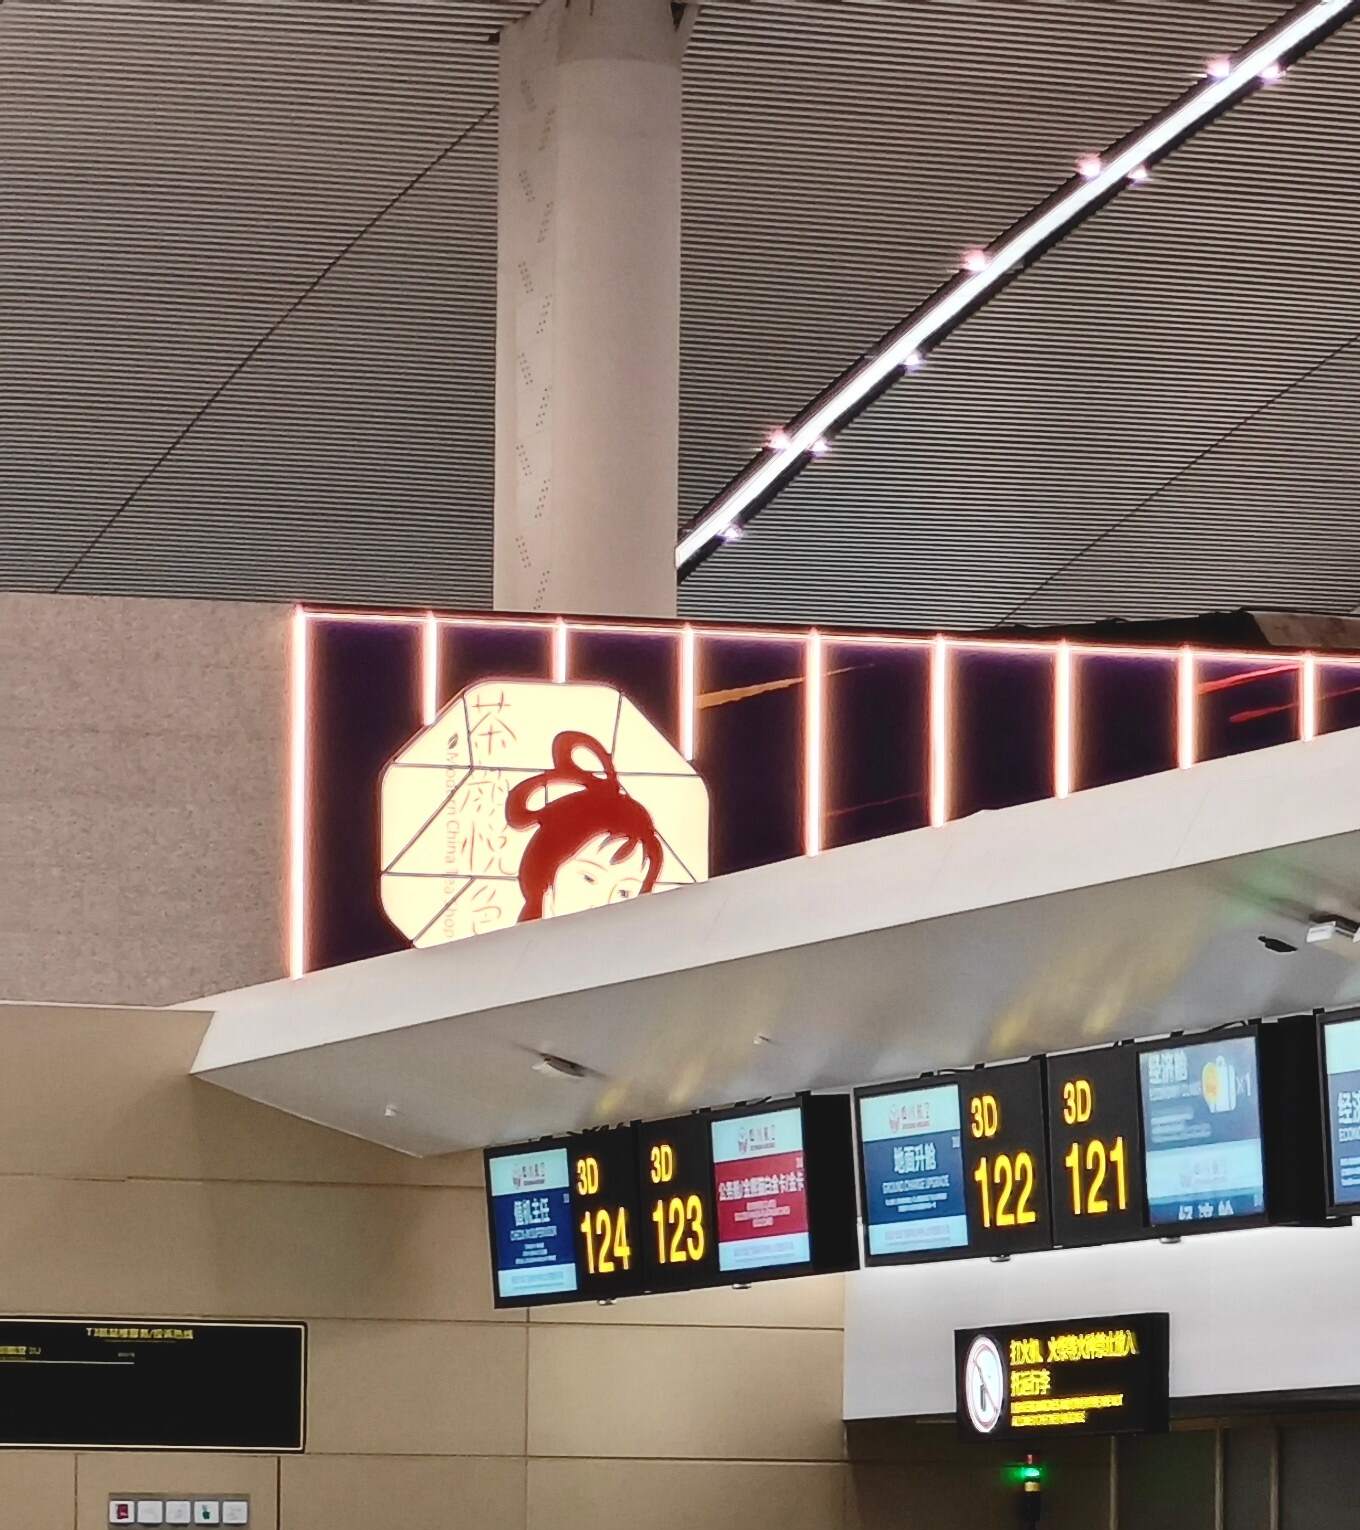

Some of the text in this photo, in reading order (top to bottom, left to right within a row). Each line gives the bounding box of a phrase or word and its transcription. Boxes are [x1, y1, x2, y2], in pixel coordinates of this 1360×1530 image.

[970, 1095, 998, 1138] 3D
[1063, 1080, 1092, 1124] 3D
[577, 1157, 599, 1195] 3D
[650, 1145, 673, 1183] 3D
[974, 1152, 1036, 1228] 122
[1065, 1137, 1127, 1214] 121
[580, 1206, 630, 1274] 124
[652, 1195, 705, 1264] 123
